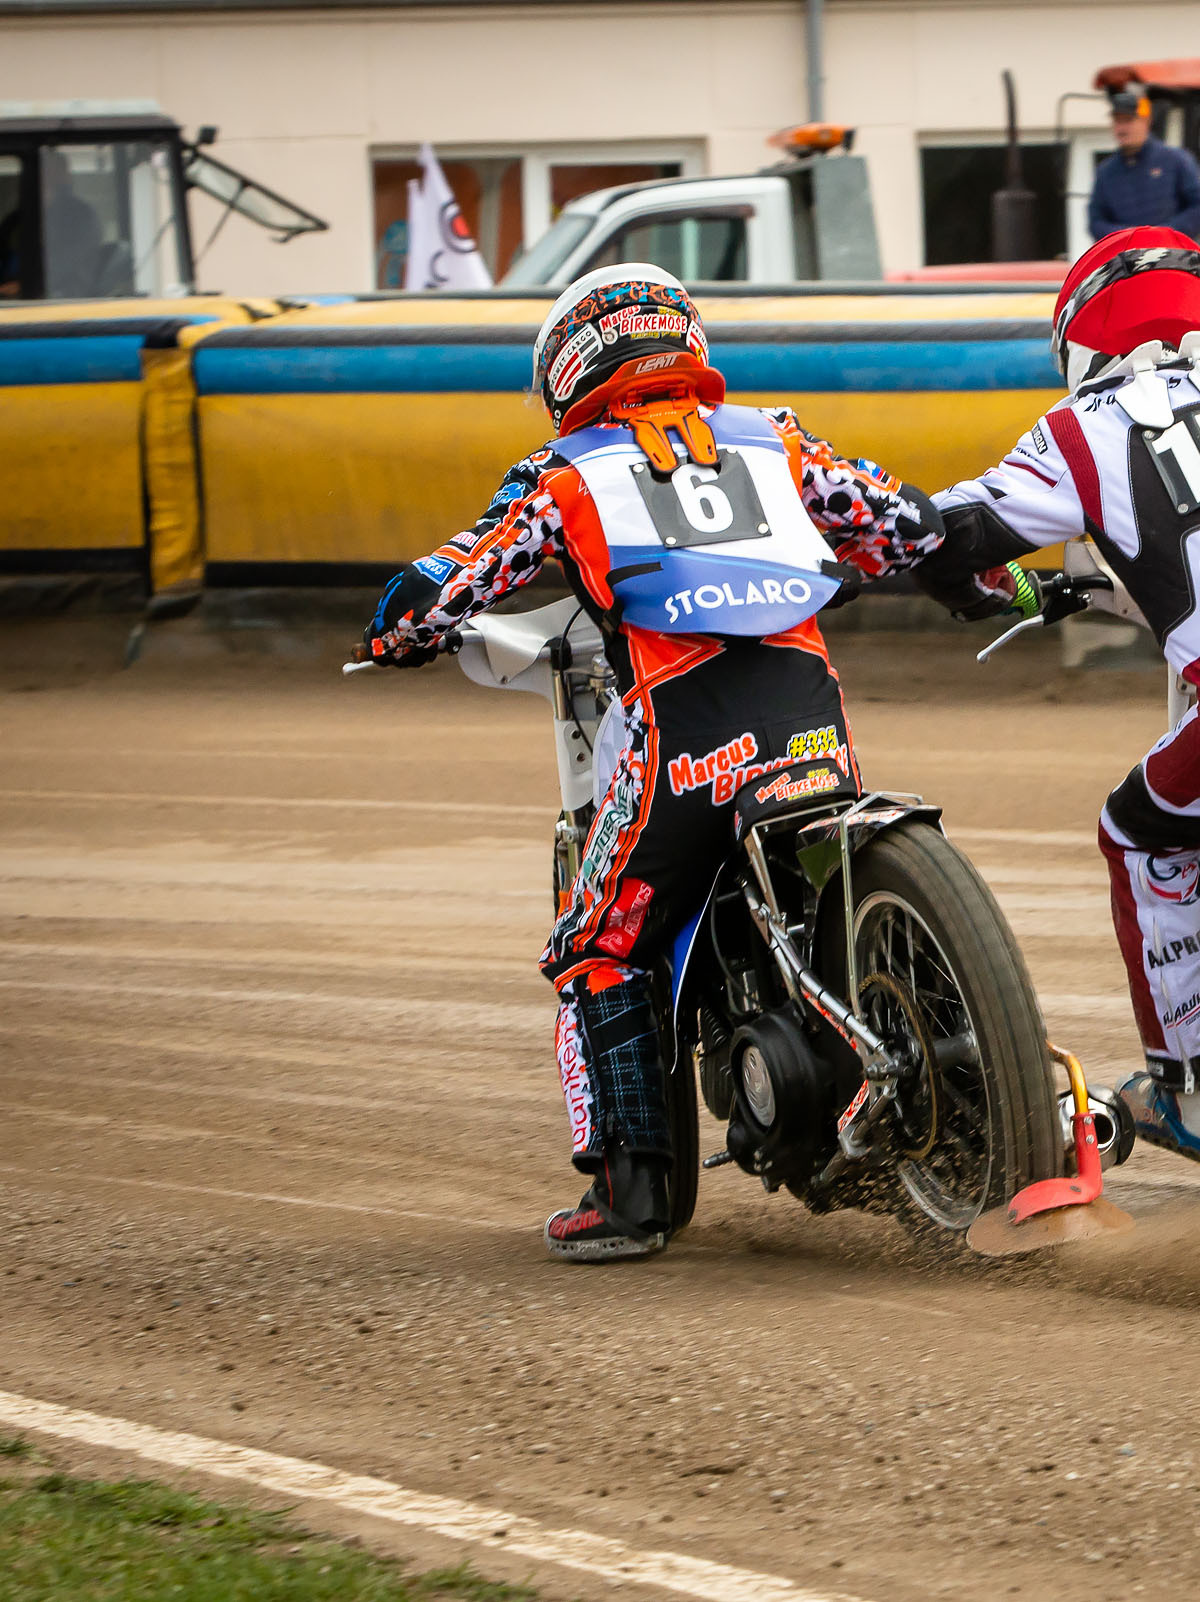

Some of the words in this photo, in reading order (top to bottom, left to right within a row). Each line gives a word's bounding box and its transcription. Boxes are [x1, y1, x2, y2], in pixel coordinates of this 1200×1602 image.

[600, 304, 641, 332] Marcus
[620, 314, 687, 334] BIRKEMOSE
[567, 330, 592, 356] CARGO
[671, 463, 734, 533] 6
[664, 577, 812, 625] STOLARO
[789, 727, 838, 759] #335
[669, 734, 756, 793] Marcus
[755, 773, 791, 803] Marcus
[777, 773, 839, 800] BIRKEMOSE
